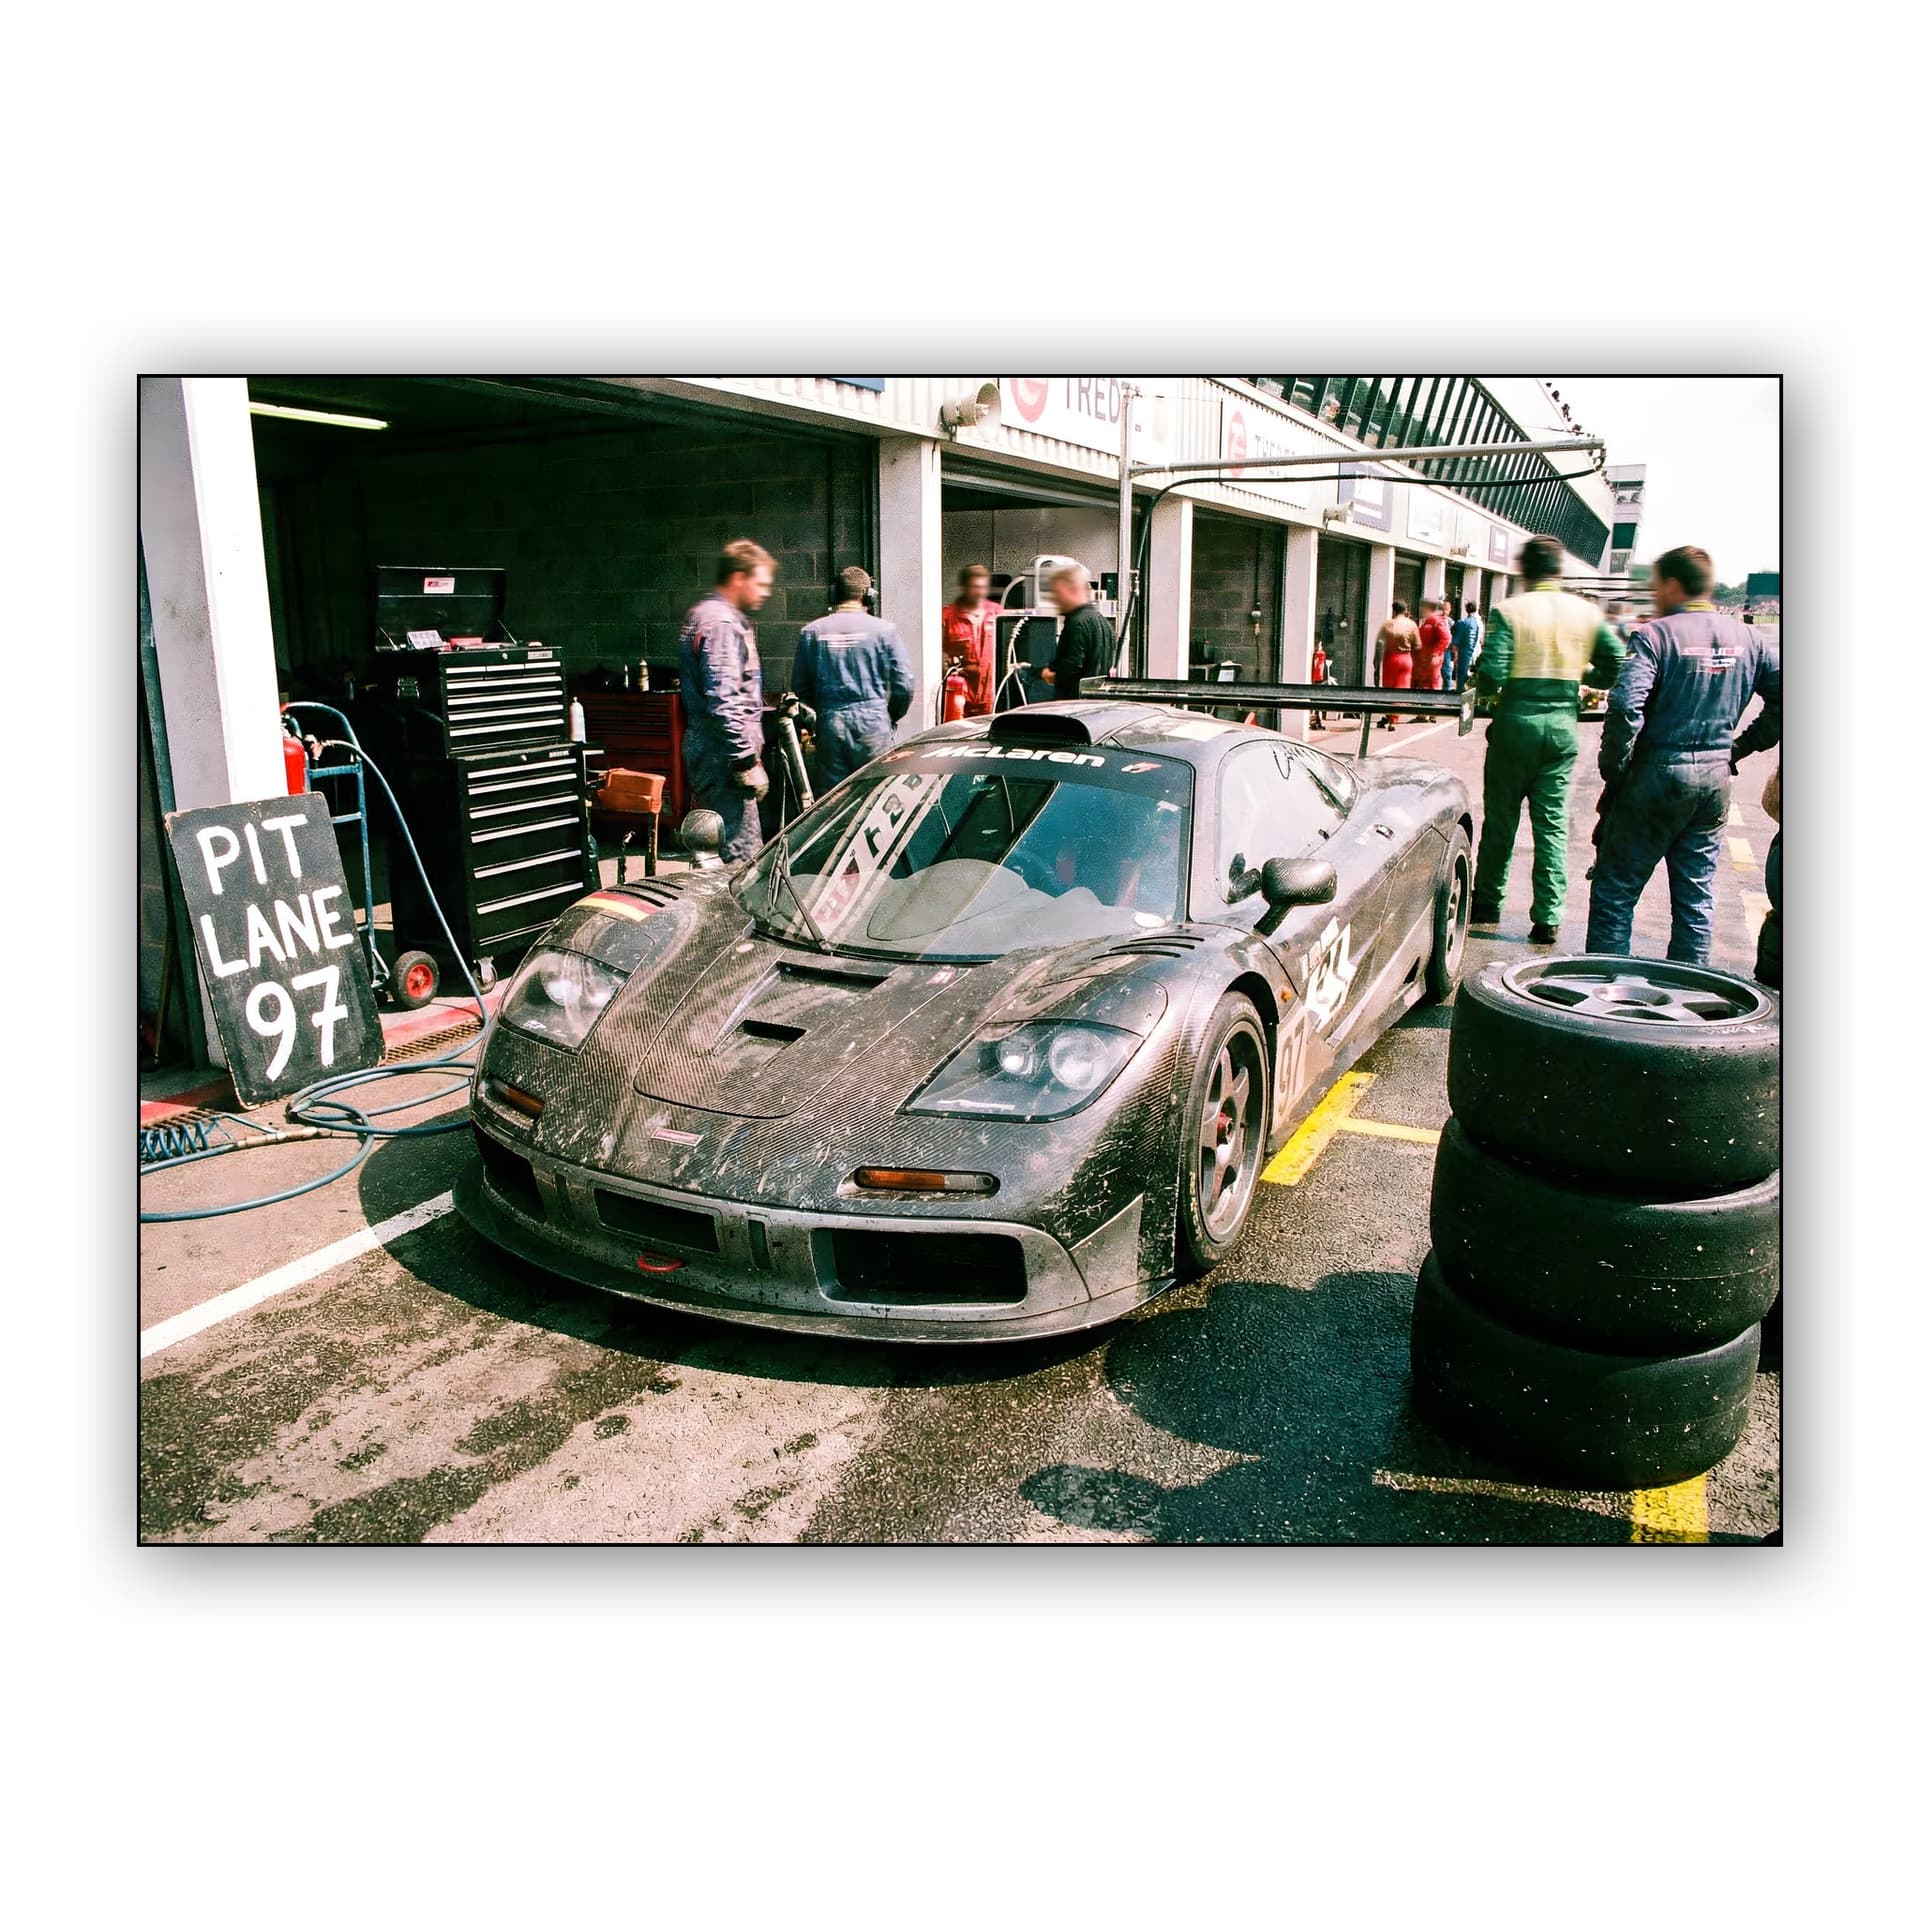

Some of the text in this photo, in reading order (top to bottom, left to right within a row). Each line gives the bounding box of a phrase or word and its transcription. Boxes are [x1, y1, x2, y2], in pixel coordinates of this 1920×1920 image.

[920, 745, 1105, 767] McLaren
[196, 814, 308, 895] PIT
[200, 885, 354, 977] LANE
[245, 965, 348, 1081] 97
